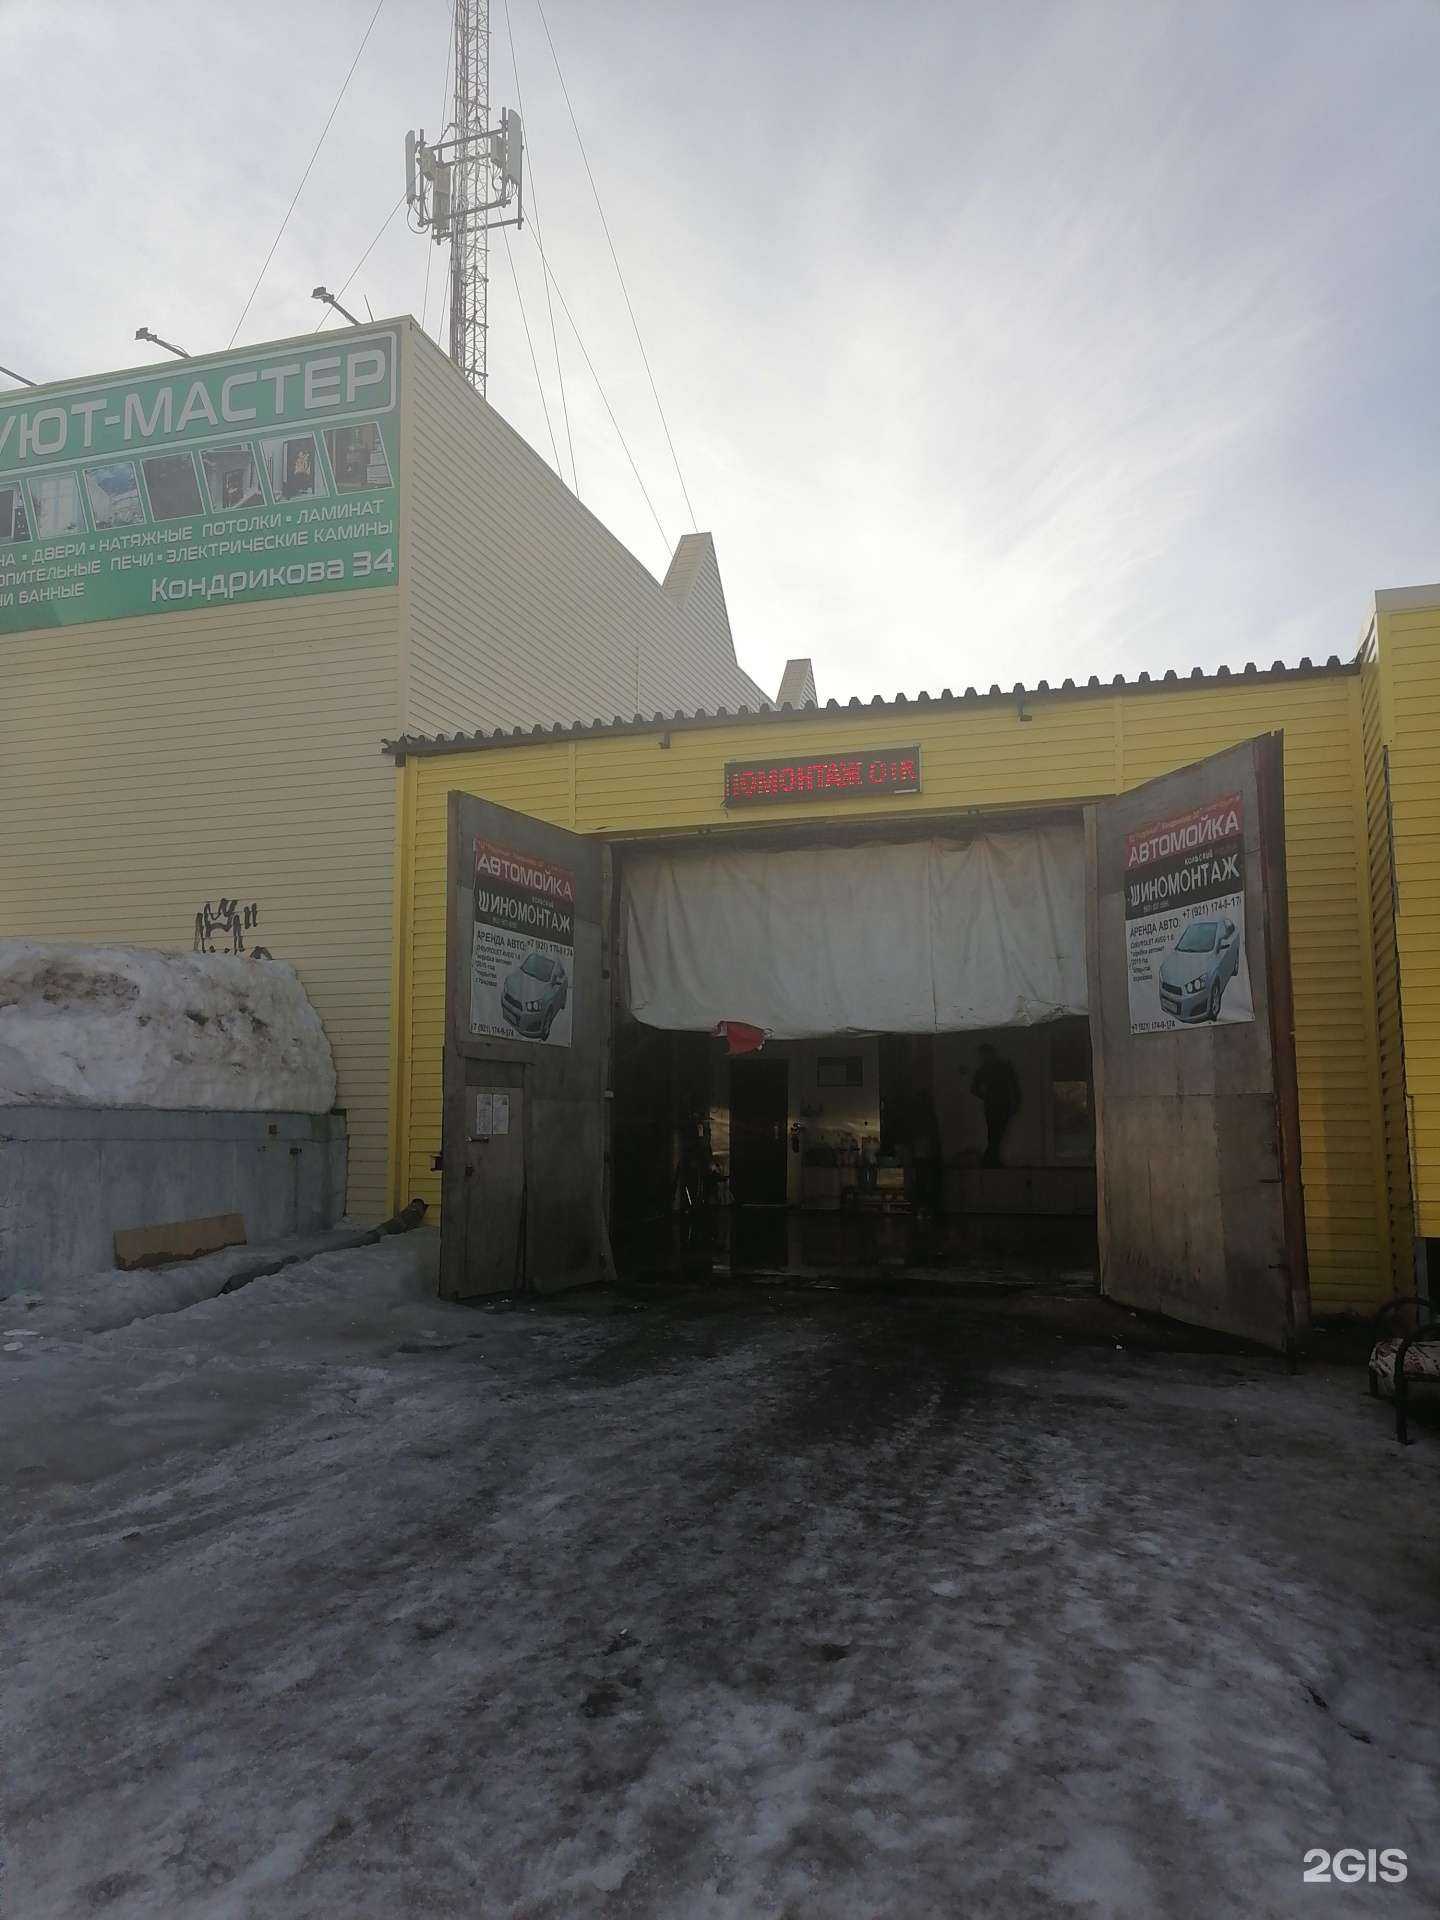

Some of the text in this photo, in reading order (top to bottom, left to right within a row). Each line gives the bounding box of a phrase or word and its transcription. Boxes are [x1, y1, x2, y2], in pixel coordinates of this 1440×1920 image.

[32, 542, 86, 565] ДВЕРИ
[99, 526, 193, 553] НАТЯЖНЫЕ
[202, 513, 281, 538] ПОТОЛКИ
[297, 500, 384, 524] ЛАМИНАТ
[110, 552, 154, 571] ПЕЧИ
[166, 531, 308, 564] ЭЛЕКТРИЧЕСКИЕ
[314, 520, 392, 544] КАМИНЫ
[19, 582, 85, 606] БАННЫЕ
[151, 548, 395, 601] Кондрикова 34
[1128, 810, 1240, 867] АВТОМОЙКА
[477, 852, 574, 902] АВТОМОЙКА
[1128, 854, 1240, 907] ШИНОМОНТАЖ
[478, 889, 571, 934] ШИНОМОНТАЖ
[1130, 924, 1157, 938] АРЕНДА
[477, 930, 505, 946] АРЕНДА
